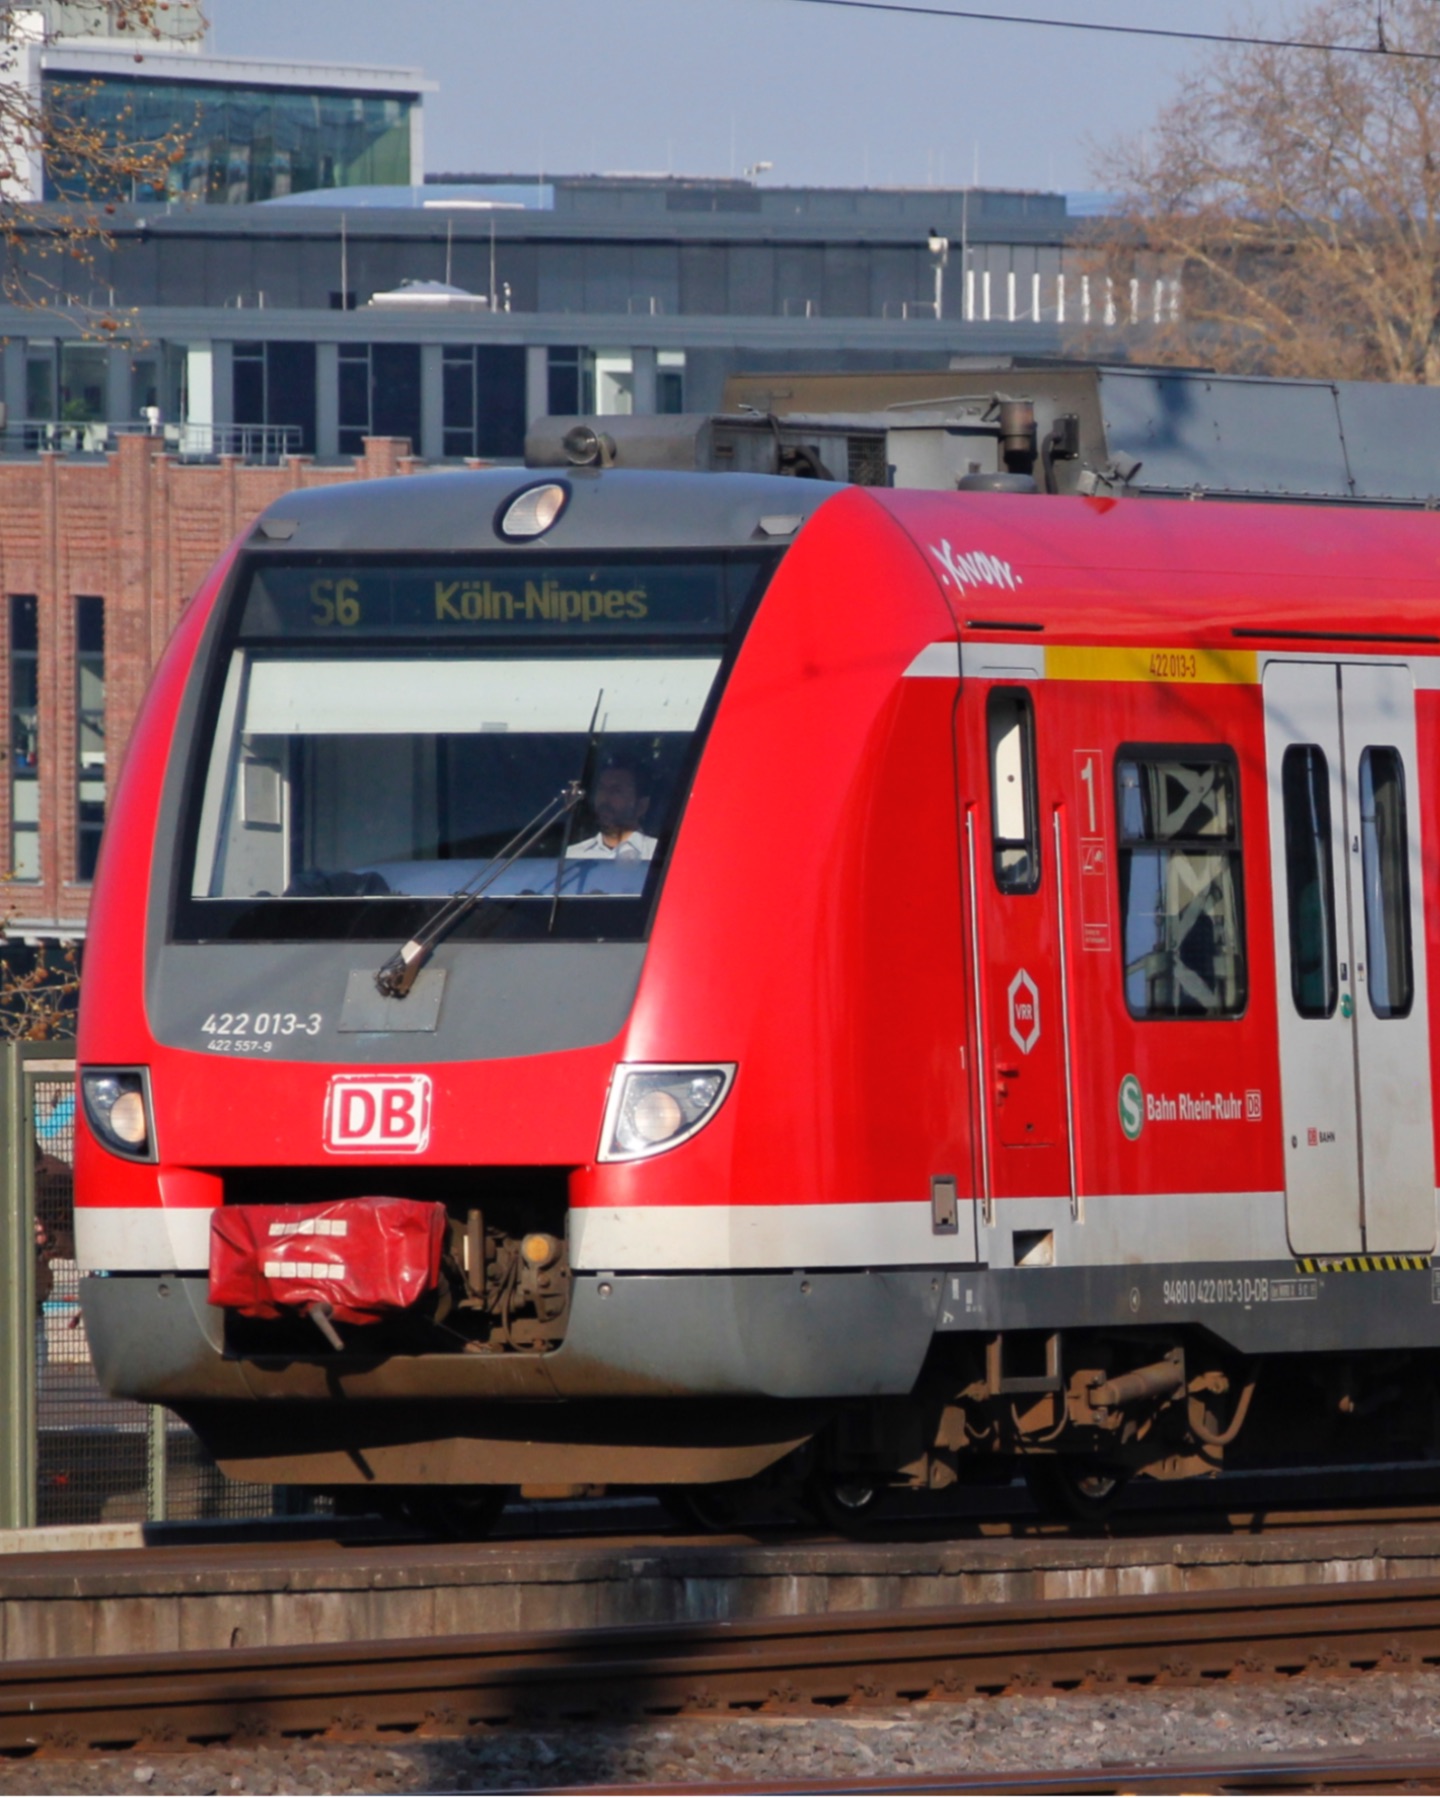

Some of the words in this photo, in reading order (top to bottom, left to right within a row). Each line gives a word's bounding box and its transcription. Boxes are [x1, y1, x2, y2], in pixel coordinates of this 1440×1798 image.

[311, 578, 360, 626] S6
[434, 579, 648, 622] Köln-Nippes
[1149, 653, 1168, 678] 422
[1170, 653, 1196, 679] 013-3
[1081, 757, 1096, 833] 1
[201, 1013, 249, 1035] 422
[253, 1013, 322, 1036] 013-3
[1015, 1004, 1033, 1020] VRR
[207, 1039, 231, 1052] 422
[234, 1040, 273, 1053] 557-9
[338, 1088, 416, 1139] DB
[1121, 1080, 1142, 1133] S
[1146, 1093, 1176, 1121] Bahn
[1178, 1091, 1242, 1120] Rhein-Ruhr
[1246, 1091, 1260, 1119] DB
[1319, 1130, 1336, 1143] BAHN
[1197, 1279, 1216, 1304] 422
[1217, 1279, 1243, 1303] 013-3
[1244, 1278, 1269, 1303] D-DB
